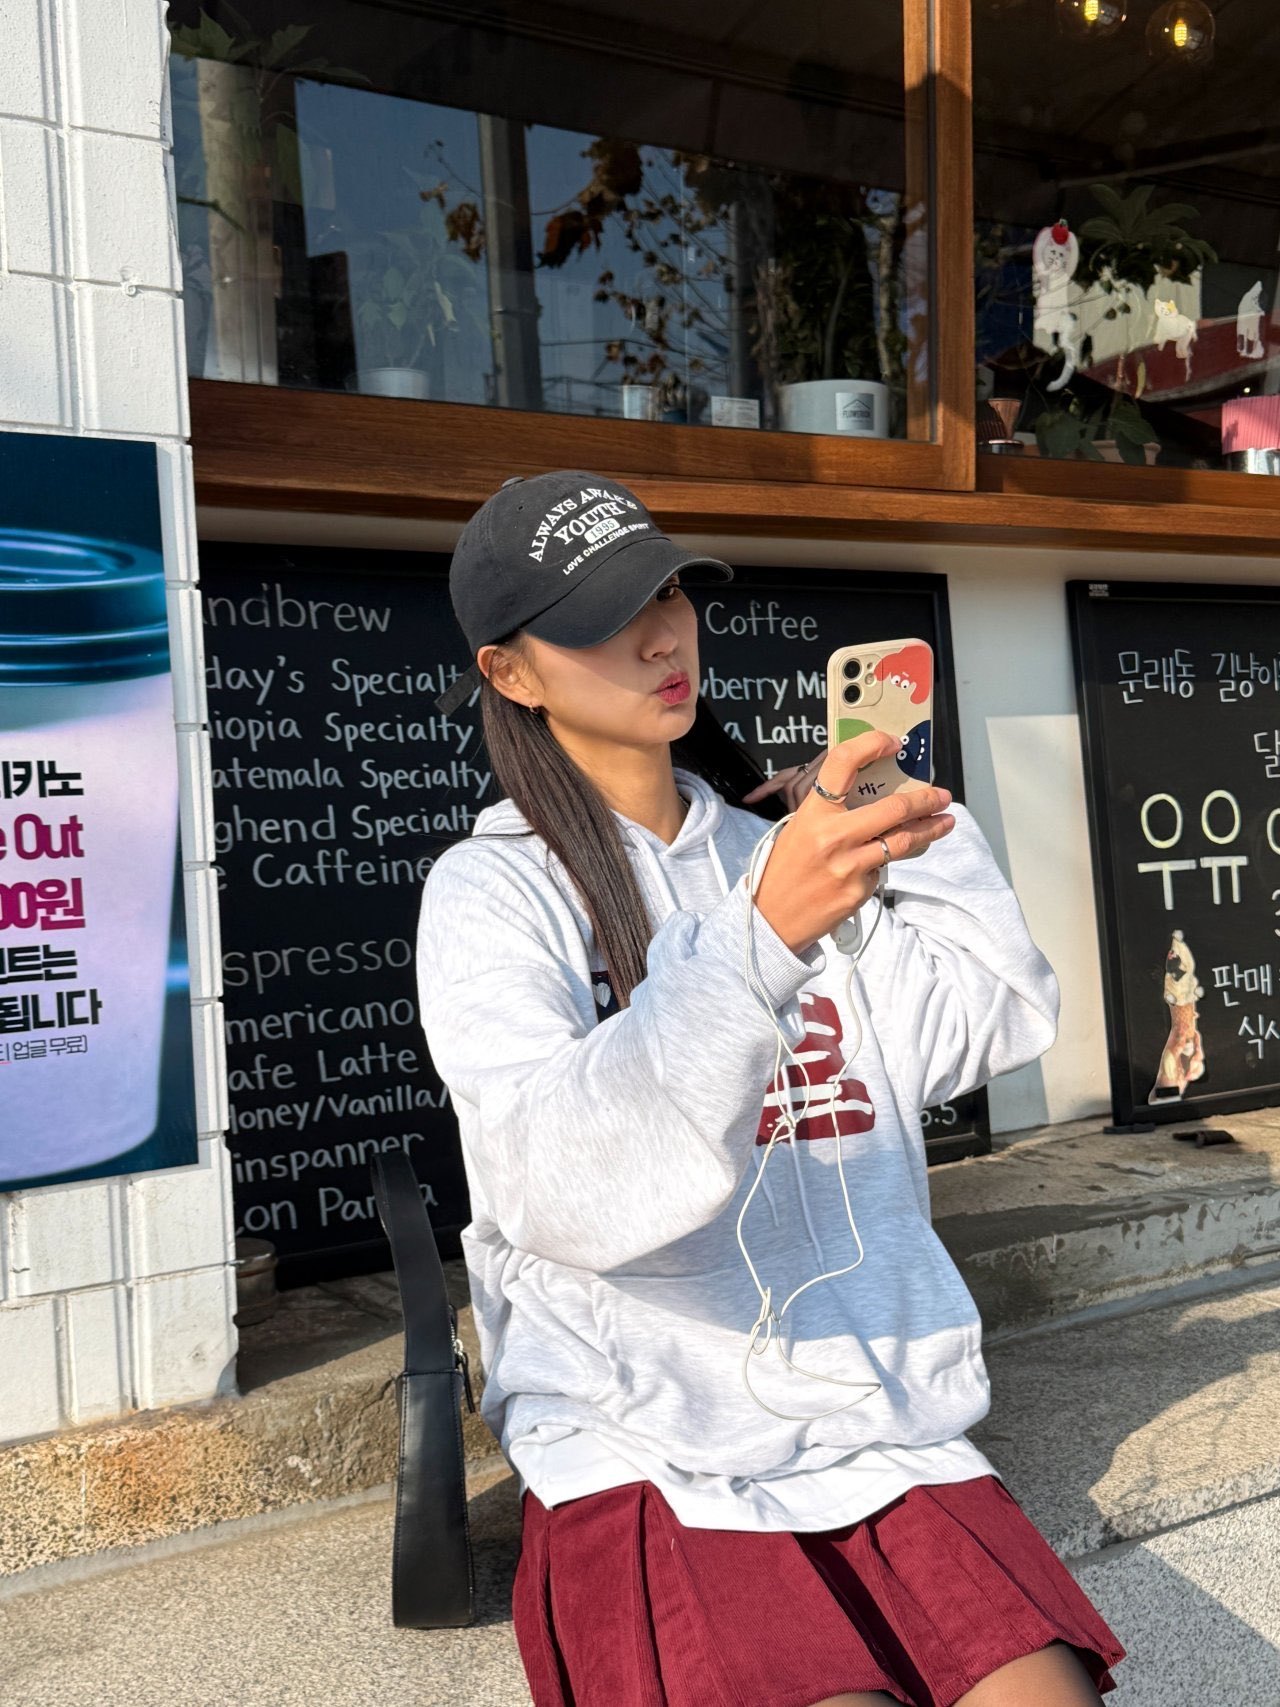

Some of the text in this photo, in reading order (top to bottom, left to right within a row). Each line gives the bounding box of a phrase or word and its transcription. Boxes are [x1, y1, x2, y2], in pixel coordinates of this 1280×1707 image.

[528, 498, 578, 563] ALWAYS
[553, 501, 626, 546] YOUTH
[589, 519, 617, 540] 1995
[562, 522, 650, 576] LOVE CHALLENGE SPIRIT
[202, 582, 392, 633] ndbrew
[705, 601, 819, 641] Coffee
[1118, 648, 1280, 704] 문래동 길냥이
[210, 710, 474, 755] iopia Specialty
[755, 715, 828, 746] Latte
[212, 757, 492, 800] atemala Specialty
[13, 812, 86, 861] Out
[213, 804, 478, 854] ghend Specialt
[1137, 789, 1249, 911] 우유
[252, 847, 436, 889] Caffeine
[0, 943, 78, 985] 트는
[222, 938, 412, 995] spresso
[0, 987, 104, 1034] 됩니다
[225, 998, 414, 1046] mericano
[228, 1042, 420, 1092] afe Latte
[235, 1199, 298, 1236] on
